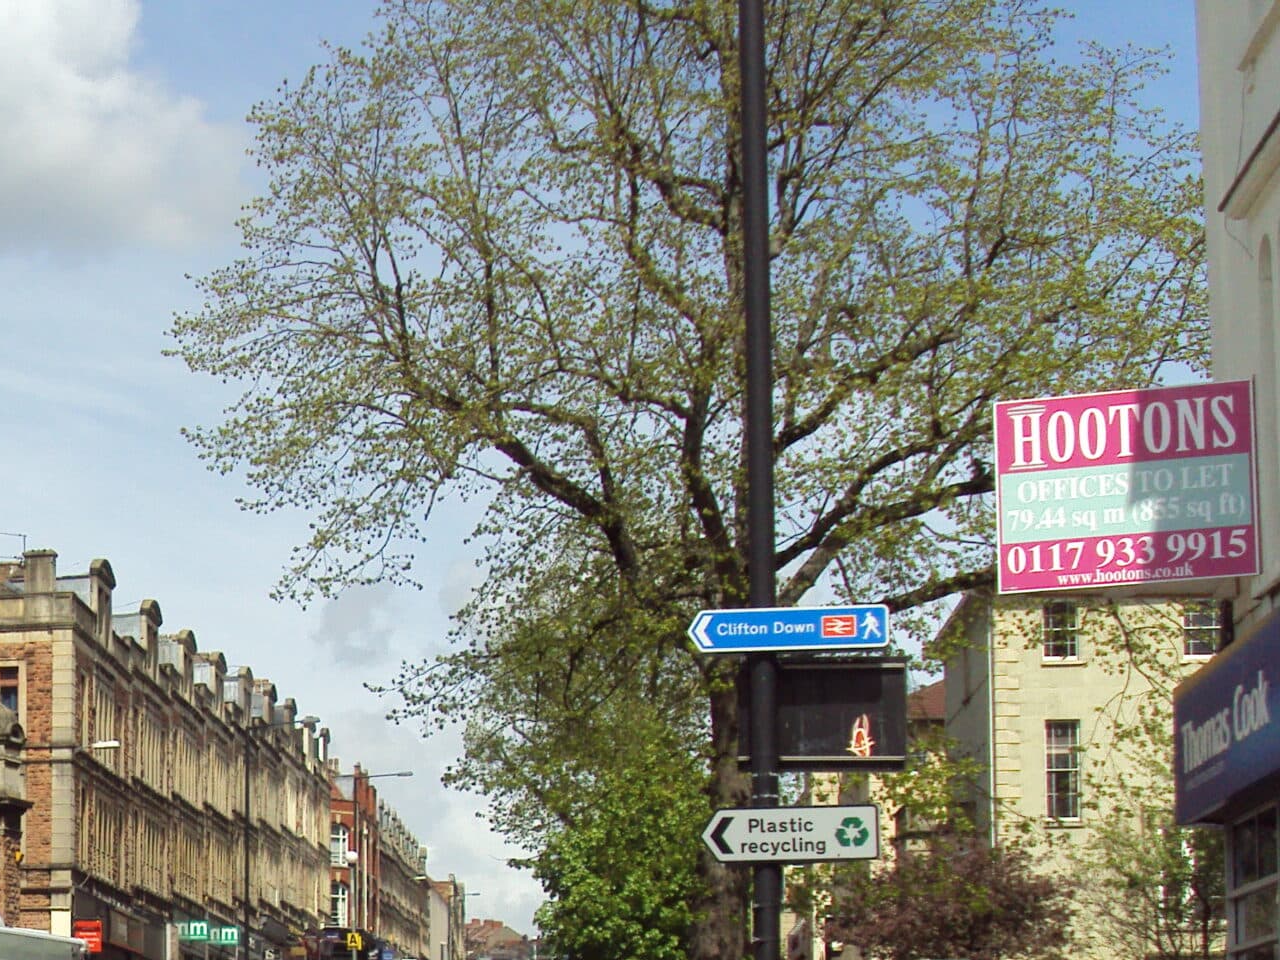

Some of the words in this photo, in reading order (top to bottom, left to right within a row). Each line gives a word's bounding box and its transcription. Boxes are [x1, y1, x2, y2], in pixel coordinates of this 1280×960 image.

[1007, 394, 1237, 470] HOOTONS
[1017, 472, 1129, 502] OFFICES
[1135, 468, 1173, 492] TO
[1181, 463, 1234, 490] LET
[1007, 506, 1065, 531] 79.44
[1072, 510, 1097, 530] sq
[1103, 506, 1125, 523] m
[1132, 497, 1180, 525] (855
[1187, 501, 1212, 523] sq
[1220, 493, 1245, 516] ft)
[1007, 541, 1085, 574] 0117
[1096, 536, 1155, 567] 933
[1167, 529, 1248, 562] 9915
[1057, 563, 1194, 585] www.hootons.co.uk
[716, 622, 767, 636] Clifton
[773, 621, 815, 634] Down
[1181, 707, 1231, 774] Thomas
[1232, 670, 1271, 741] Cook
[748, 818, 813, 833] Plastic
[740, 837, 826, 855] recycling
